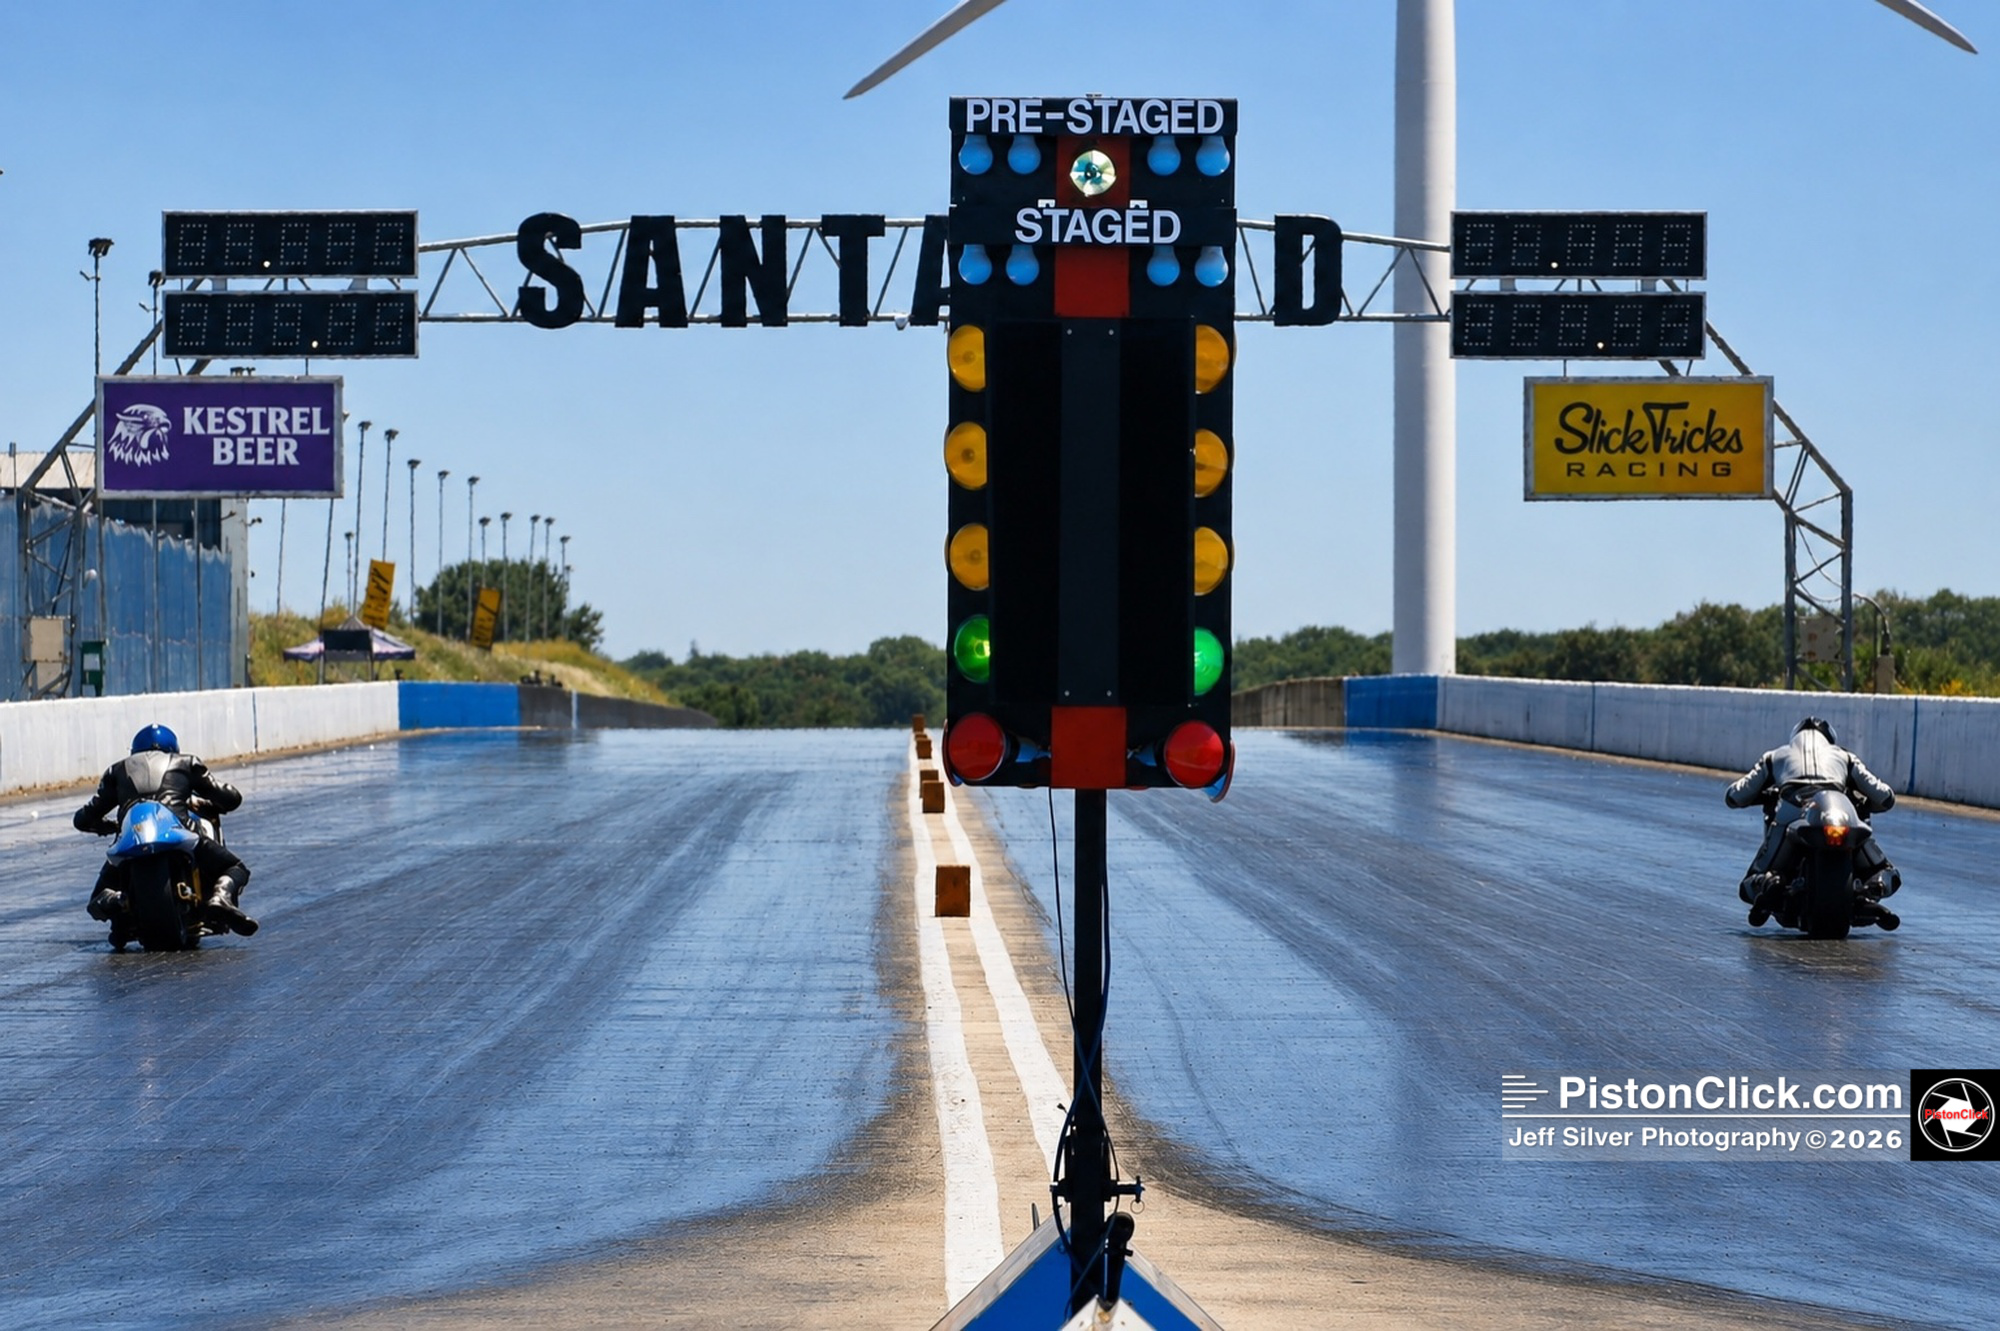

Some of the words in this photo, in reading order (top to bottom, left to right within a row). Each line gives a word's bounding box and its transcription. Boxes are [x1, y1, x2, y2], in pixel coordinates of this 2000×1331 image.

[966, 99, 1224, 134] PRE-STAGED
[1015, 208, 1181, 244] STAGED
[183, 407, 330, 434] KESTREL
[213, 438, 299, 465] BEER
[1567, 462, 1732, 477] RACING
